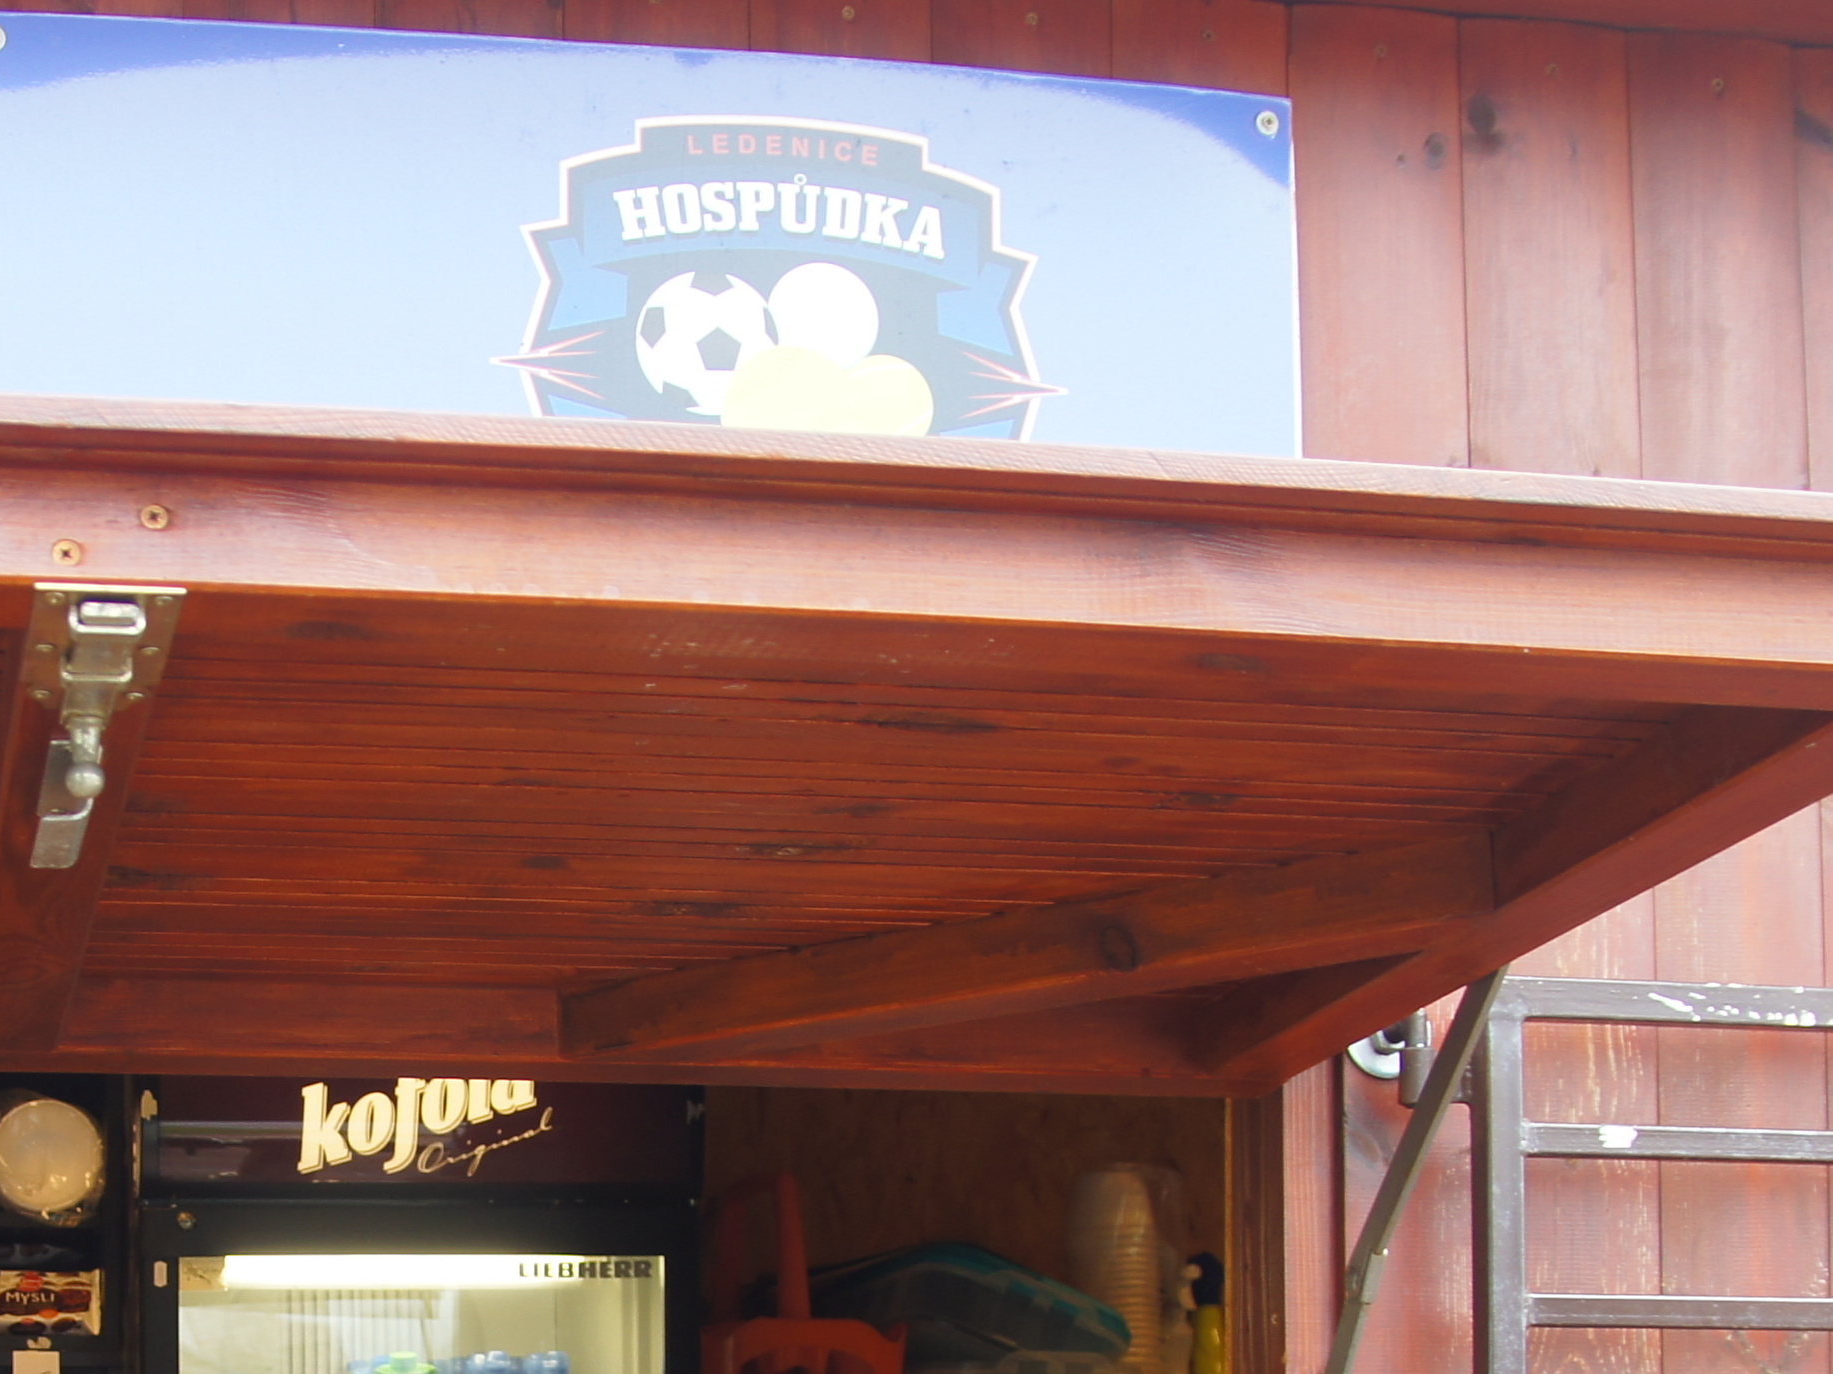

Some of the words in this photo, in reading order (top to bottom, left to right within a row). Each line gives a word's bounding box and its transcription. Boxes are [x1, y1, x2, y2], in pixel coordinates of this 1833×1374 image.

[687, 133, 880, 167] LEDENICE
[612, 172, 946, 261] HOSPŮDKA
[518, 1258, 652, 1279] LIEBHERR
[5, 1290, 55, 1304] MYSLI
